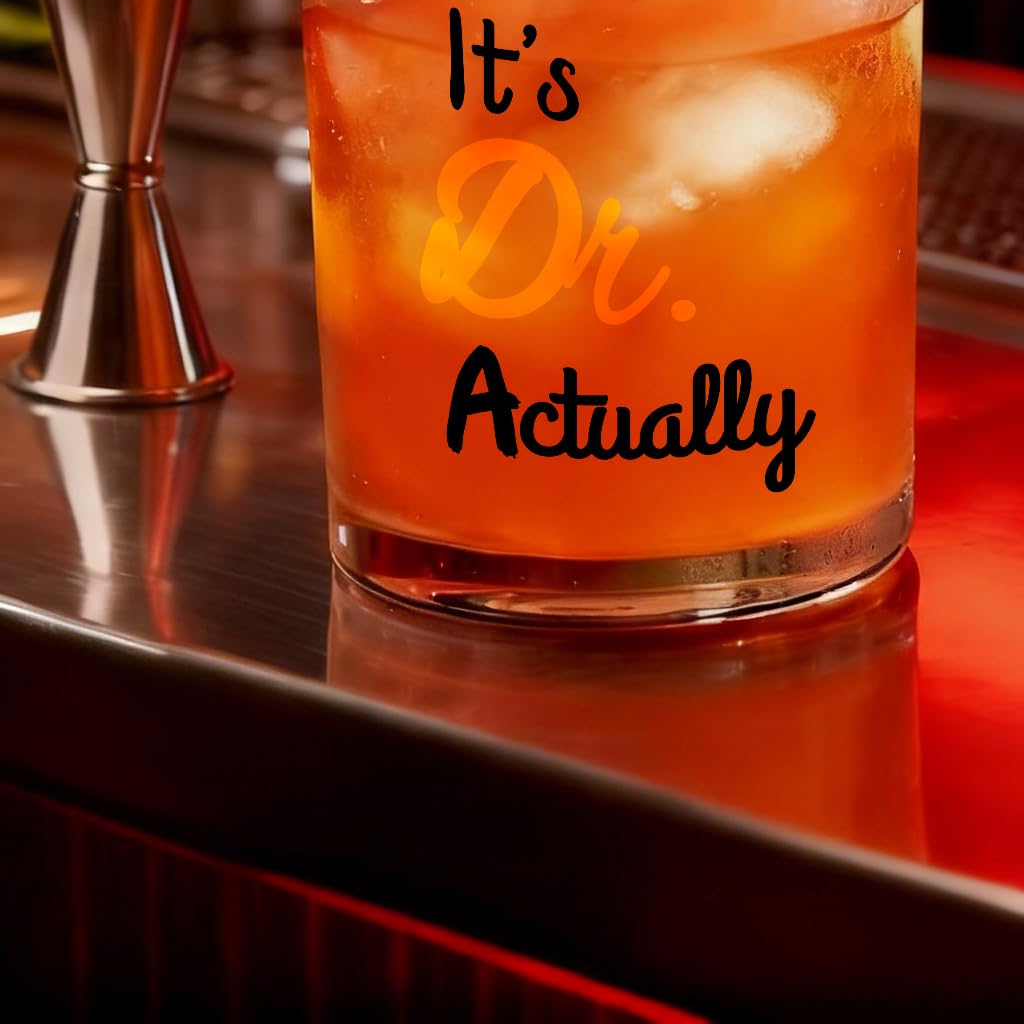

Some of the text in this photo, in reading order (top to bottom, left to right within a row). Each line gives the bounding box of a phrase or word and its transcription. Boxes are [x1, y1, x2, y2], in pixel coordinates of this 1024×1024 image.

[449, 7, 581, 122] It's
[420, 138, 696, 325] Dr.
[446, 344, 817, 493] Actually
